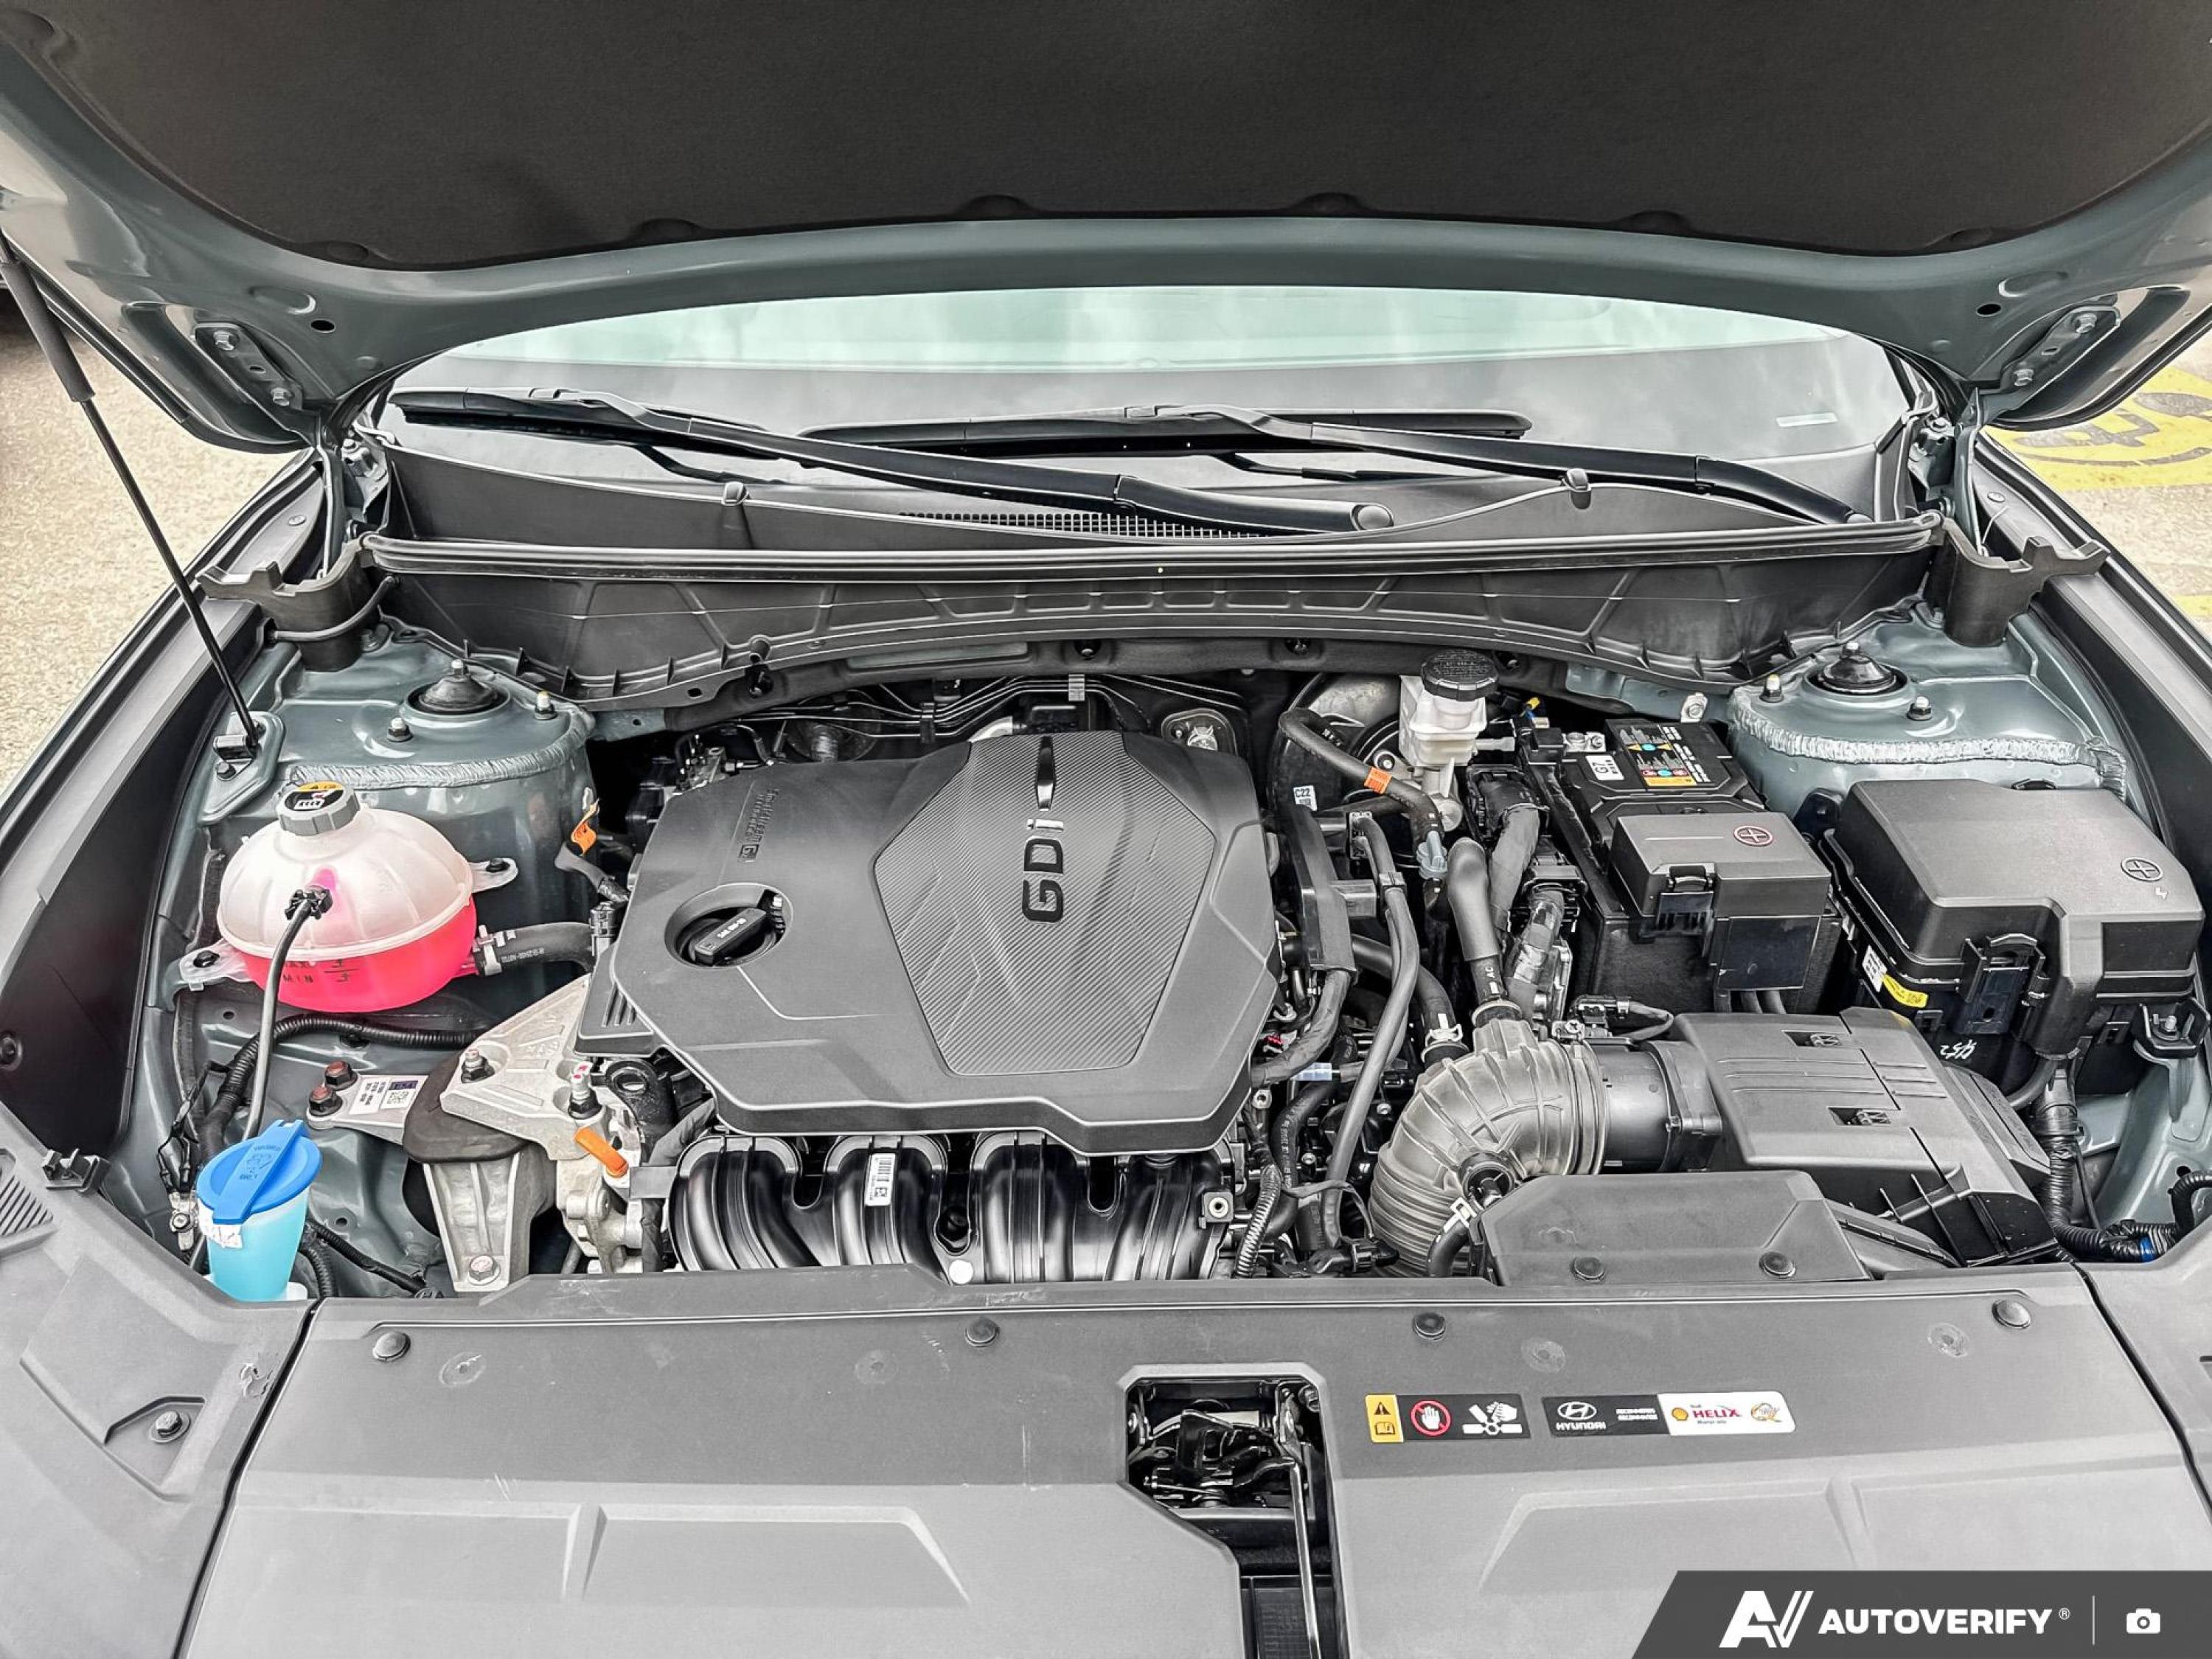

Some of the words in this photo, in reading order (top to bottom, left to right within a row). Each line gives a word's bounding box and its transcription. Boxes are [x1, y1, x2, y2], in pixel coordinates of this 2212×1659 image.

[1295, 787, 1311, 797] C22
[1022, 818, 1064, 923] GDi
[1692, 1408, 1742, 1419] HELIX
[1556, 1421, 1607, 1430] HYUNDAI
